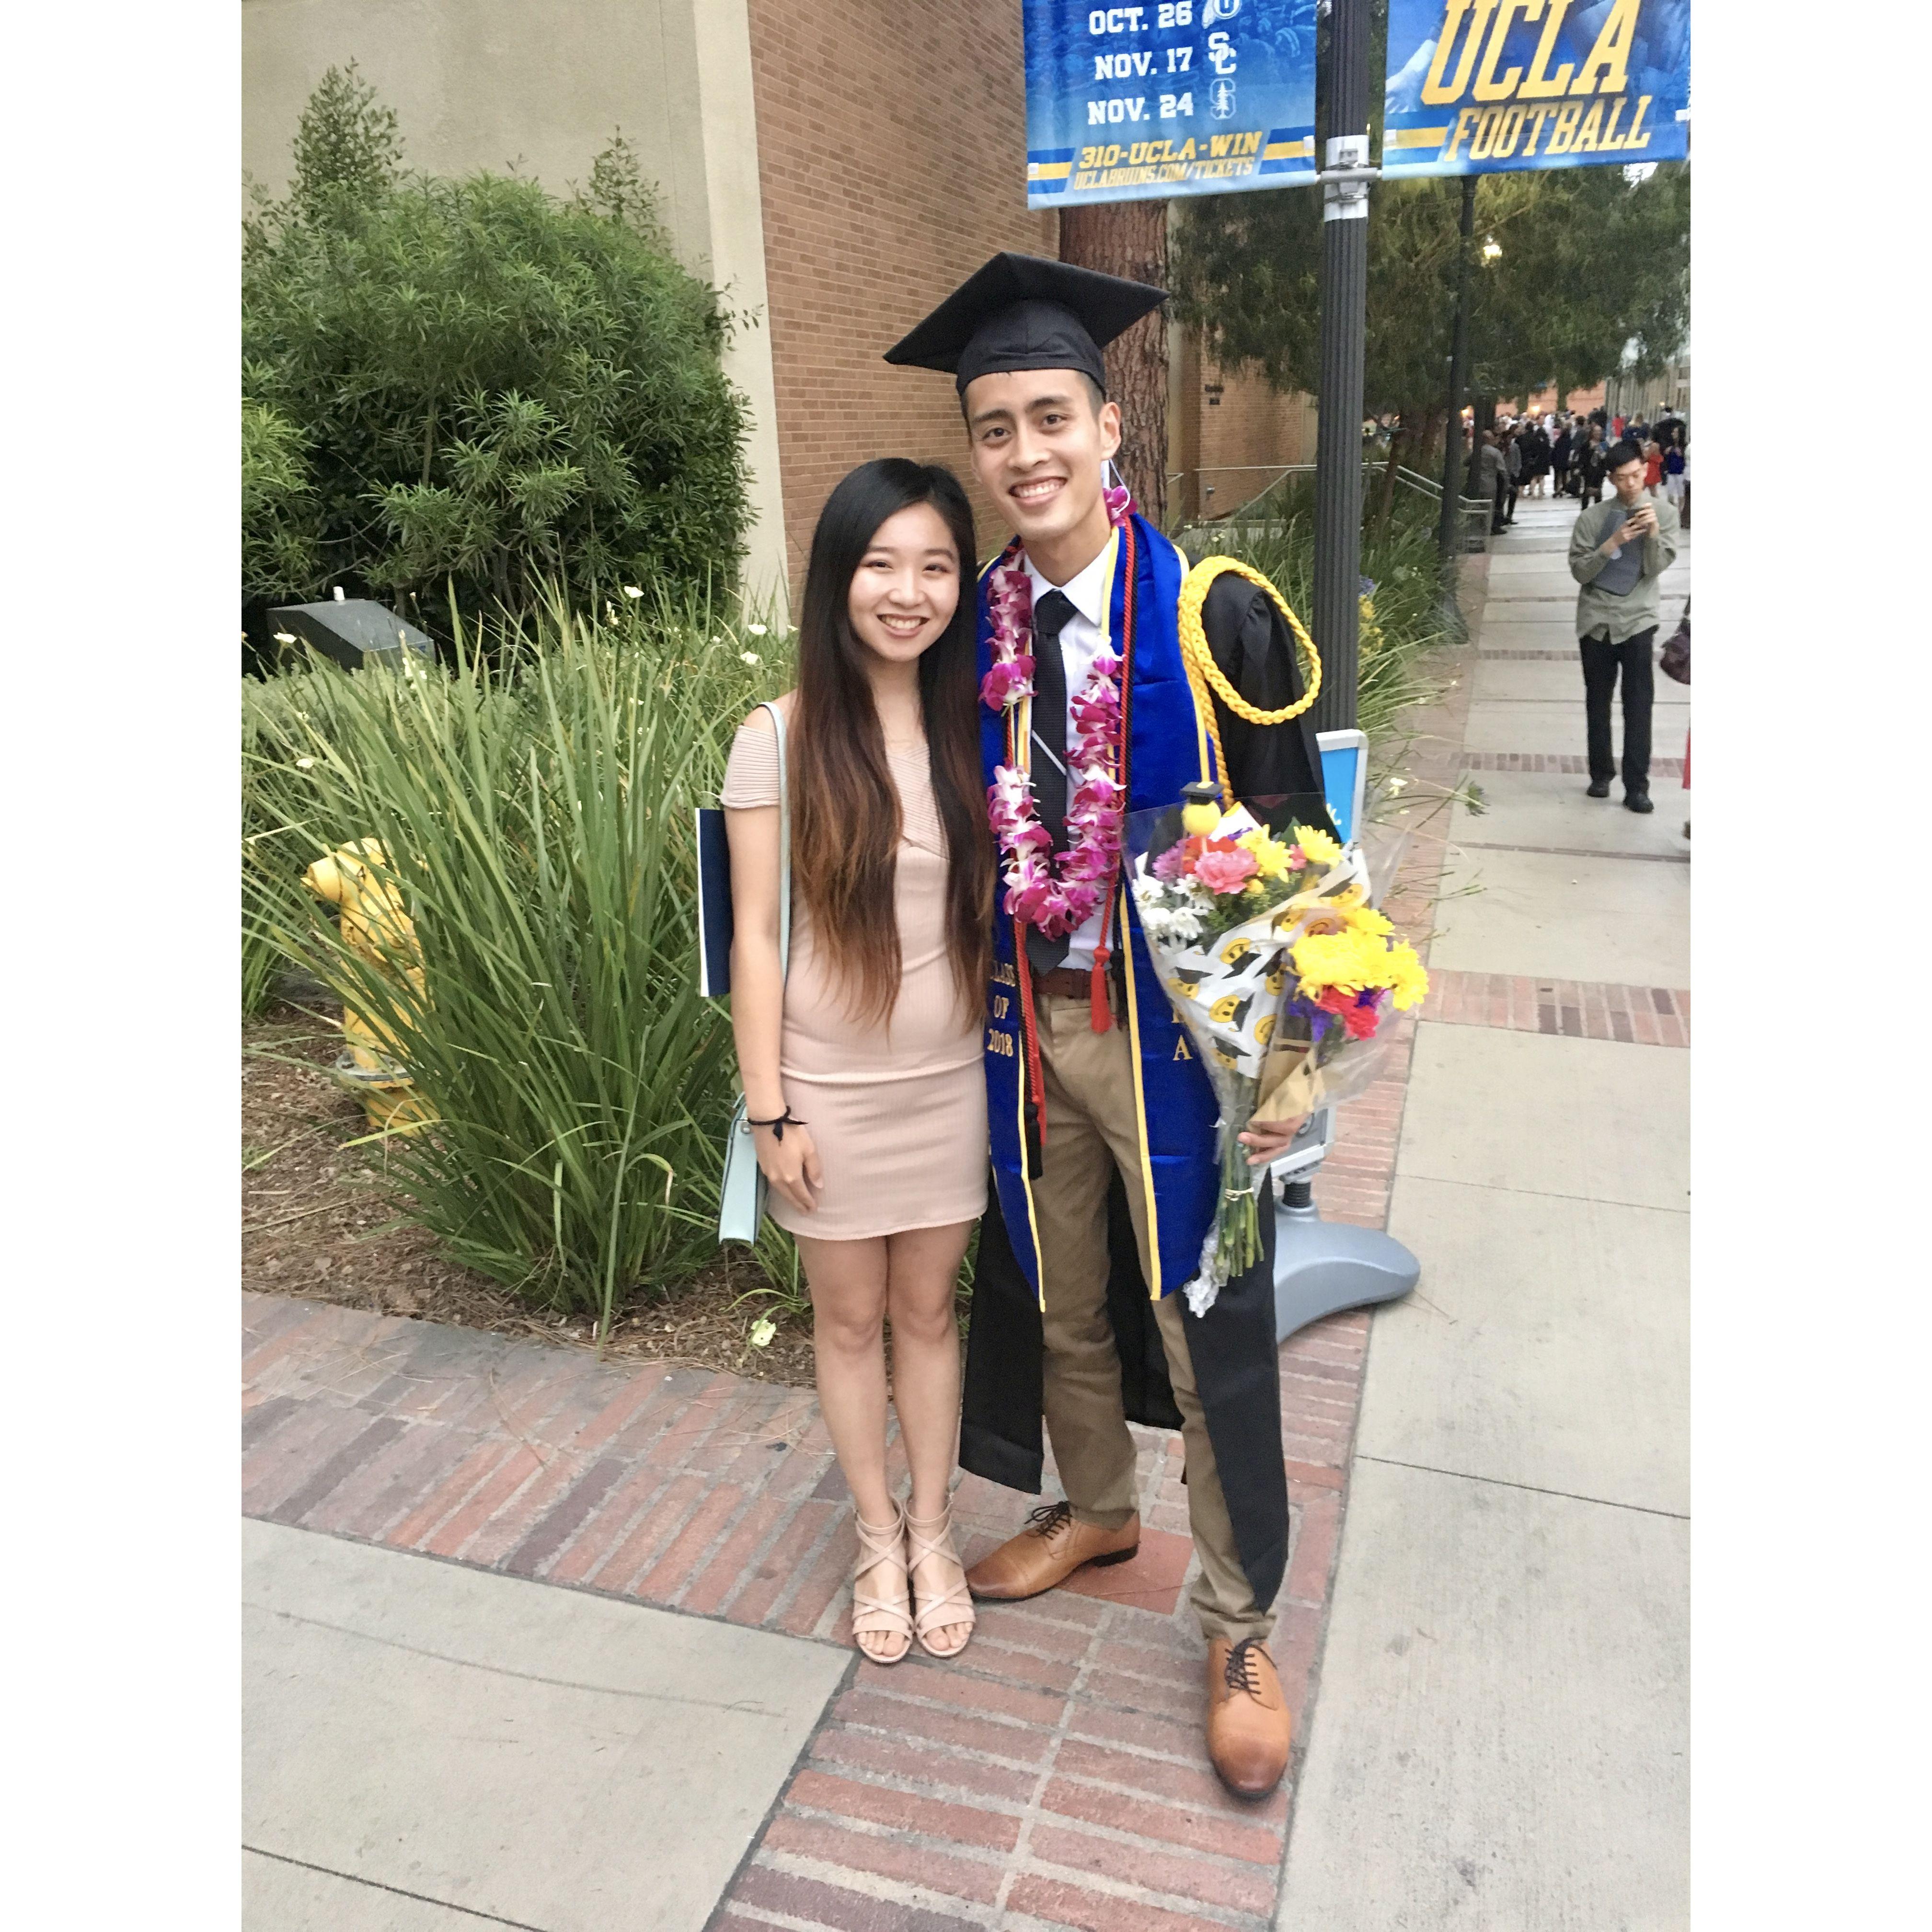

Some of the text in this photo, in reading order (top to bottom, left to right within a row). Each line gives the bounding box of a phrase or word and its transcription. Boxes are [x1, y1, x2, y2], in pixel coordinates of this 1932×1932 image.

[1089, 7, 1148, 34] OCT.
[1158, 0, 1193, 28] 26
[1094, 52, 1157, 80] NOV.
[1167, 47, 1193, 72] 17
[1420, 0, 1640, 104] UCLA
[1088, 98, 1150, 125] NOV.
[1160, 93, 1194, 118] 24
[1444, 95, 1652, 162] FOOTBALL
[1079, 131, 1263, 169] 310-UCLA-WIN
[1074, 156, 1255, 190] UCLABRUINS.COM/TICKETS
[990, 960, 1015, 987] LASS
[994, 995, 1010, 1019] OF
[987, 1028, 1014, 1057] 2018
